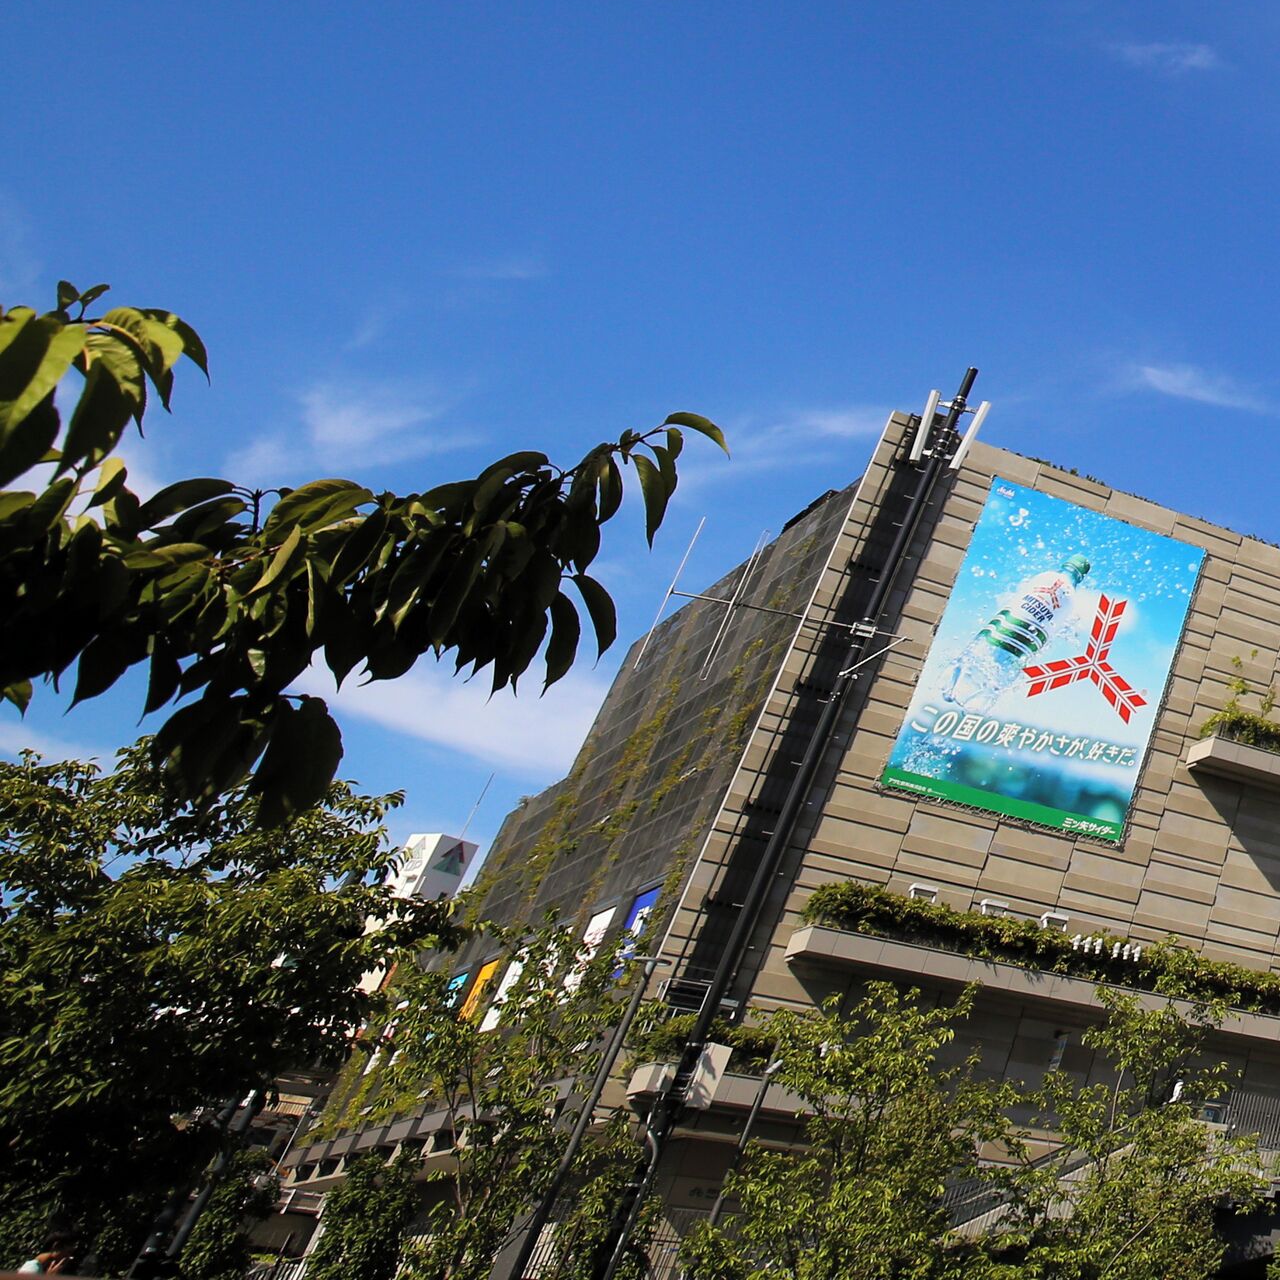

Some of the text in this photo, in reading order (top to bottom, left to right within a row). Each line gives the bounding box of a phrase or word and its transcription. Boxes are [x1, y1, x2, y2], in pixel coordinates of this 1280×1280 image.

[1020, 602, 1046, 622] CIDER
[1023, 594, 1054, 621] MITSUYA
[911, 705, 1137, 766] この国の爽やかさが、好きだ。
[1062, 817, 1115, 835] 三ツ矢サイダー
